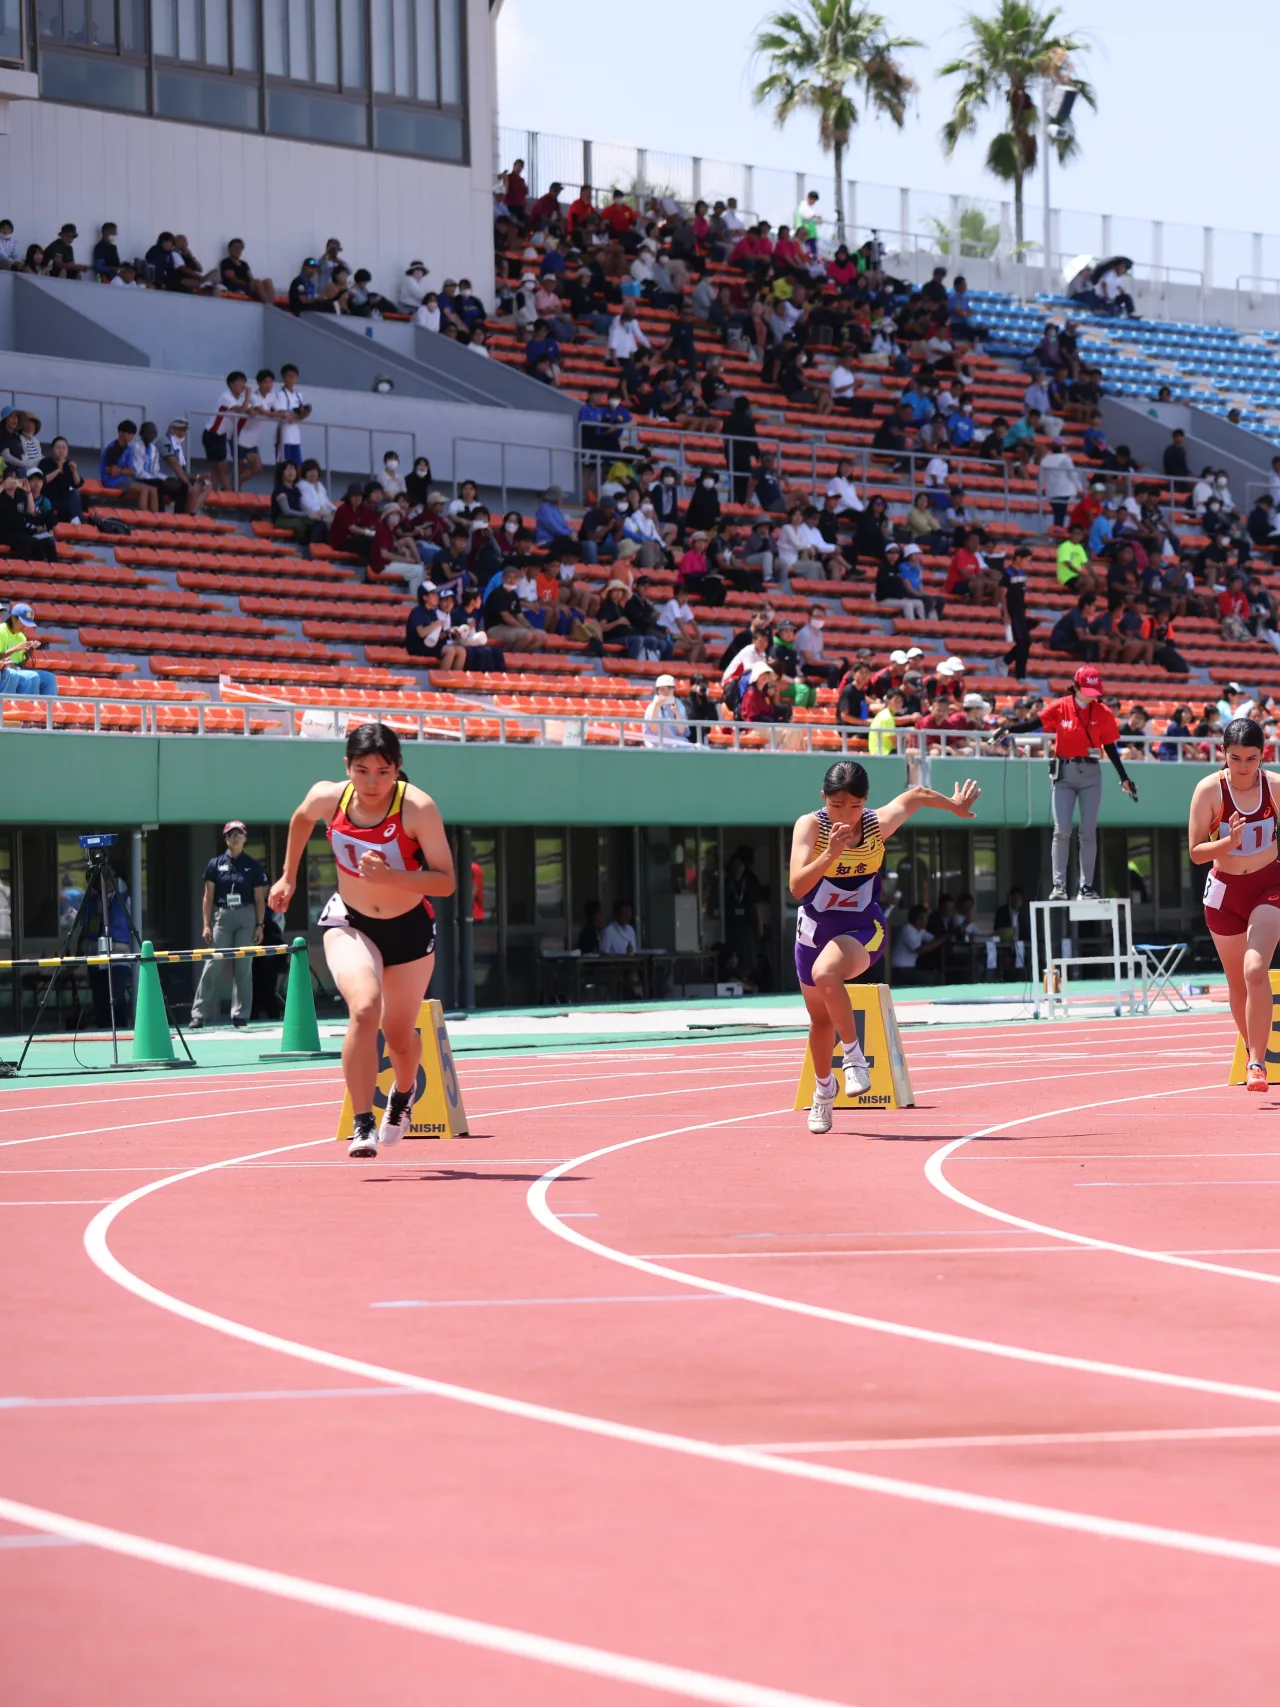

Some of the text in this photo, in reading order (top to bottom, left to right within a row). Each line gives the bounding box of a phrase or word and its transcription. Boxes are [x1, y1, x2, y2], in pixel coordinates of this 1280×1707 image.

[835, 862, 868, 875] 知念
[437, 1026, 459, 1108] 5
[858, 1095, 891, 1104] NISHI
[409, 1123, 446, 1133] NISHI
